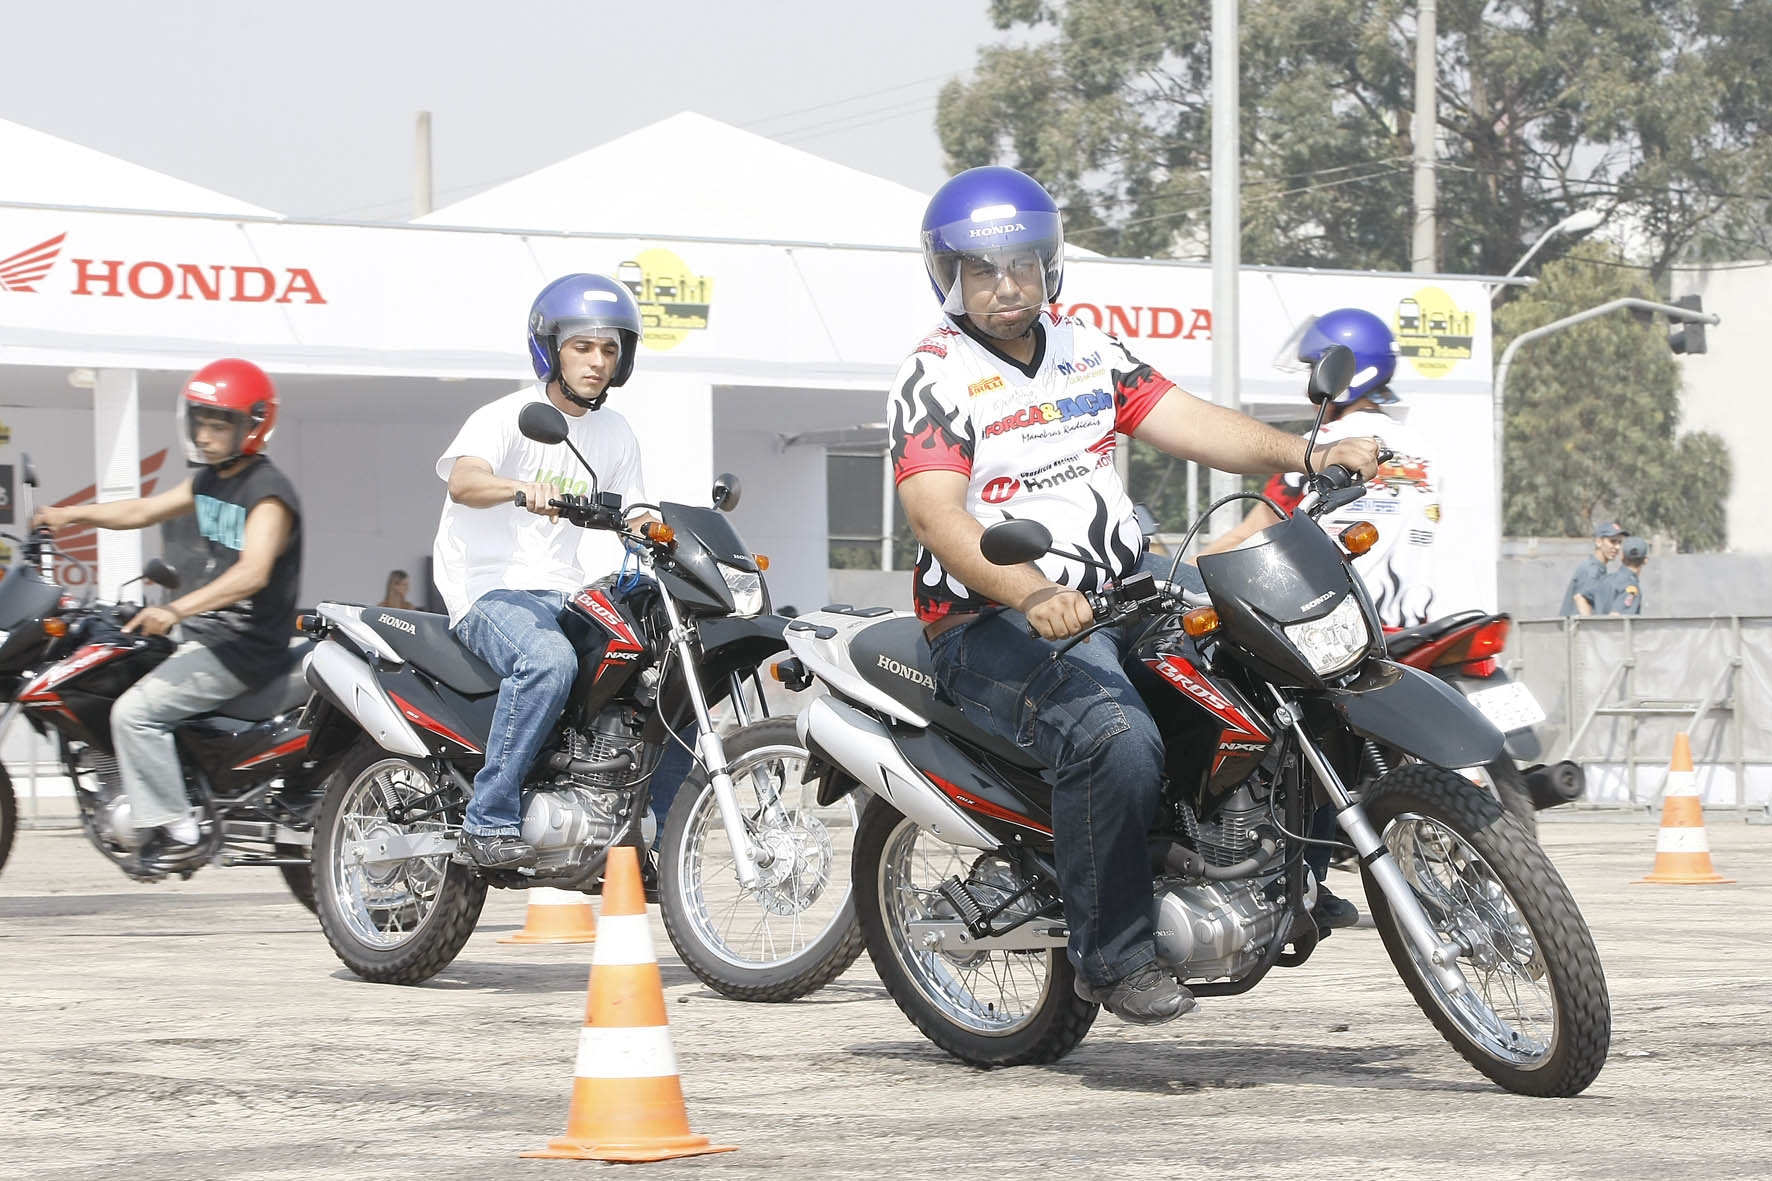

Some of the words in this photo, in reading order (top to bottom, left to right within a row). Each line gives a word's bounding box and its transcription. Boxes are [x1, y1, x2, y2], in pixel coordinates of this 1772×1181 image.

[969, 223, 1026, 238] HONDA
[71, 258, 328, 305] HONDA
[1049, 302, 1213, 340] ONDA
[1057, 351, 1103, 376] Mobil
[1023, 464, 1090, 493] Honda
[577, 593, 623, 625] BROS
[1300, 590, 1336, 613] HONDA
[378, 613, 416, 636] HONDA
[605, 651, 639, 660] NXR
[877, 654, 935, 690] HONDA
[1156, 660, 1233, 710] BROS
[1219, 743, 1266, 752] NXR
